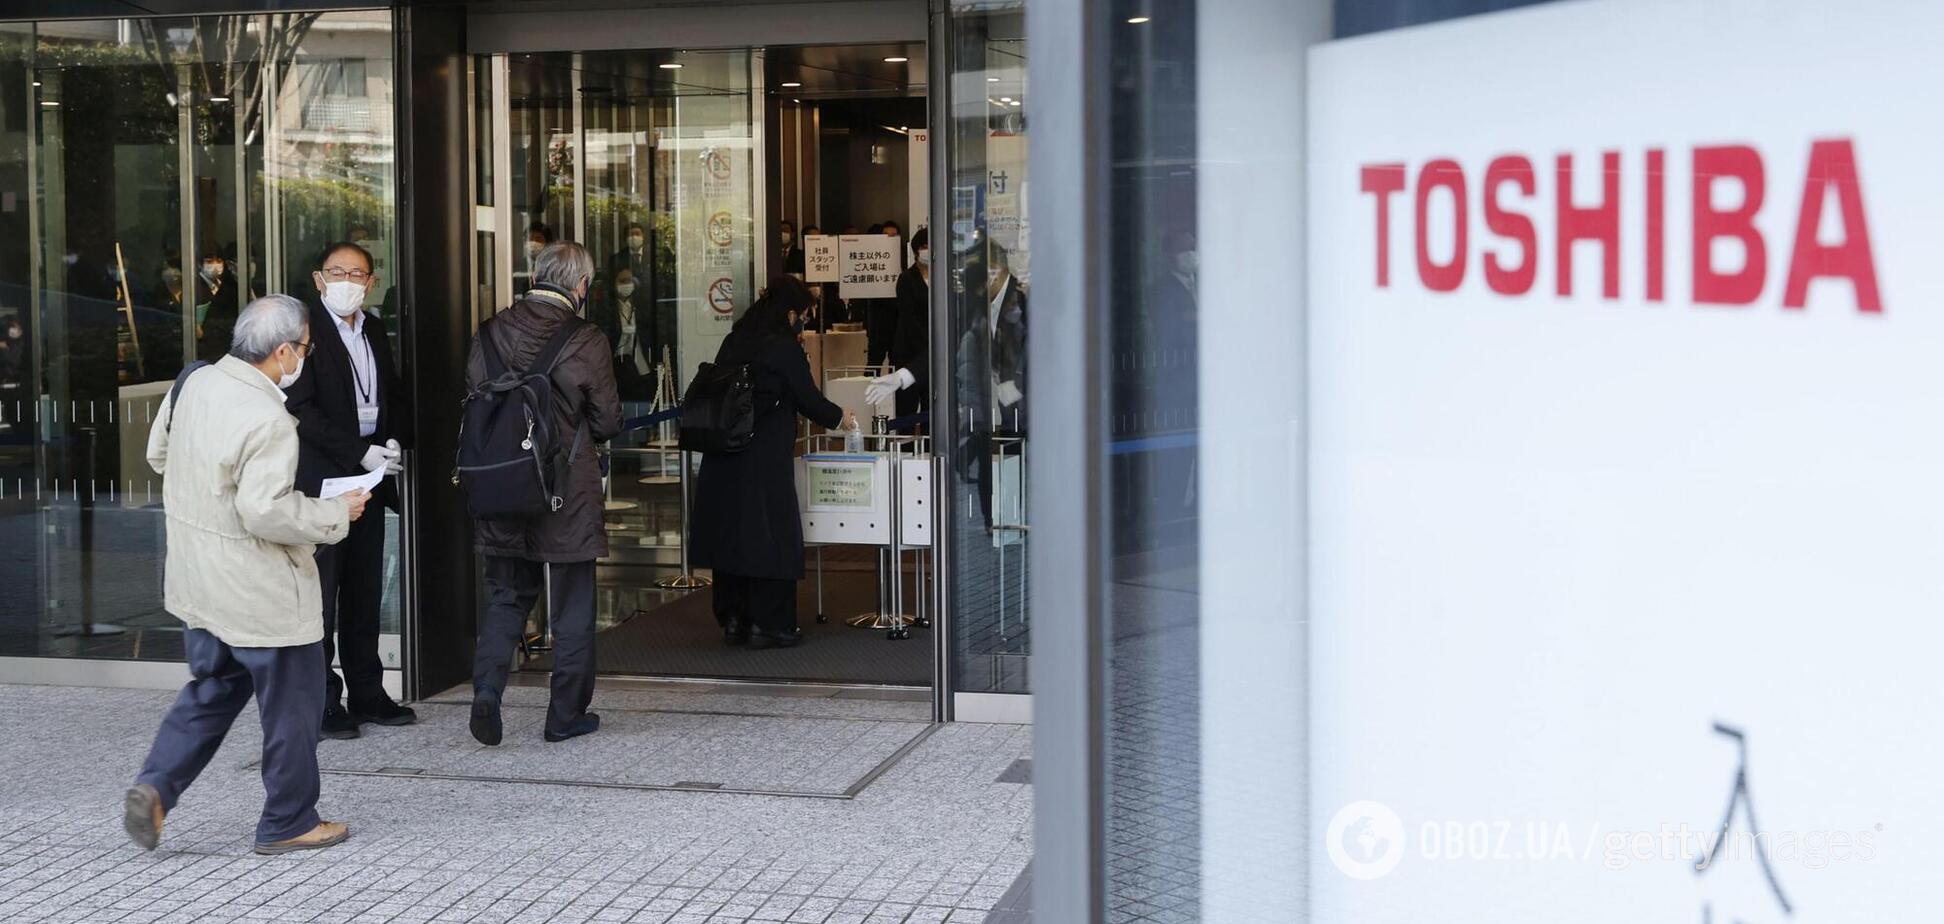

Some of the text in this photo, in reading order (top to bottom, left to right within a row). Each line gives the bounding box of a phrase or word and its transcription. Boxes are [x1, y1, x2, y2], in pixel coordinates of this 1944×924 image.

[1361, 137, 1883, 314] TOSHIBA
[815, 247, 829, 255] 社員
[849, 251, 891, 260] 株主以外の
[809, 255, 835, 263] スタッフ
[815, 264, 829, 272] 受付
[854, 262, 886, 272] ご入場は
[843, 274, 898, 283] ご遠慮願います
